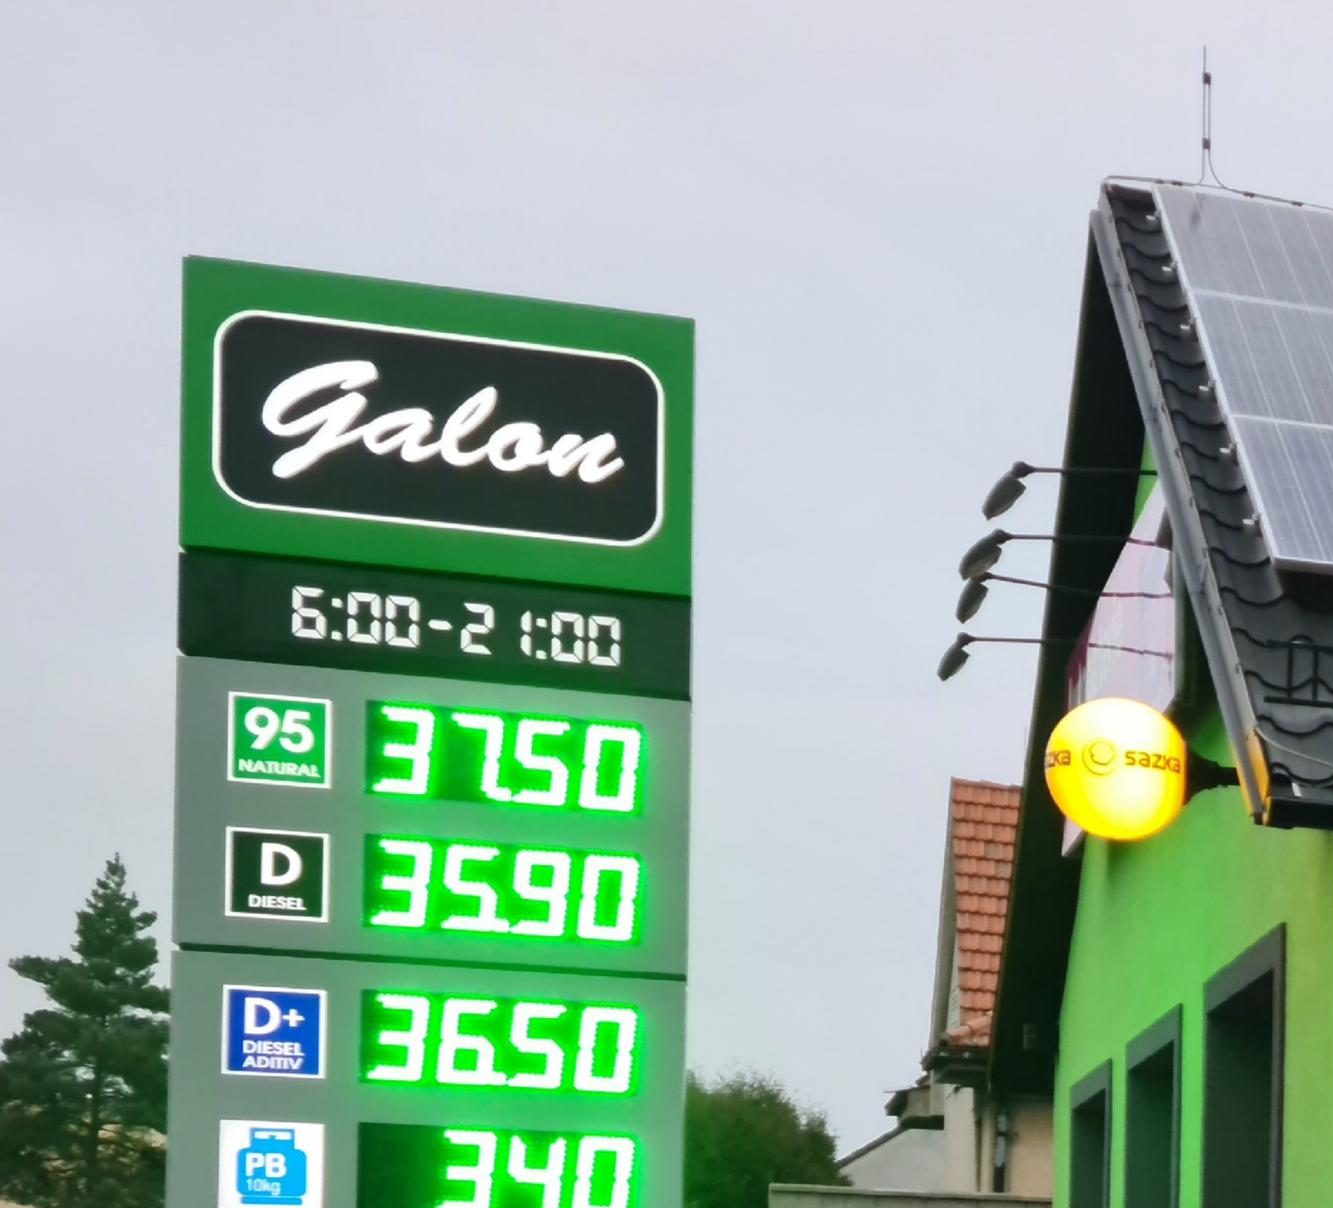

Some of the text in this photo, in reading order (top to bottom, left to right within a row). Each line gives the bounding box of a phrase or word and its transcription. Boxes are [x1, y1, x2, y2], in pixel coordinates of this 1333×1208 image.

[262, 360, 625, 483] Galon
[244, 706, 316, 754] 95
[238, 758, 321, 778] NATURAL
[1045, 750, 1071, 768] zka
[1124, 751, 1182, 774] sazka
[260, 842, 303, 886] D
[247, 894, 308, 910] DIESEL
[243, 996, 306, 1036] D+
[242, 1040, 305, 1056] DIESEL
[242, 1055, 304, 1070] ADITIV
[245, 1152, 287, 1178] PB
[245, 1178, 281, 1196] 10kg
